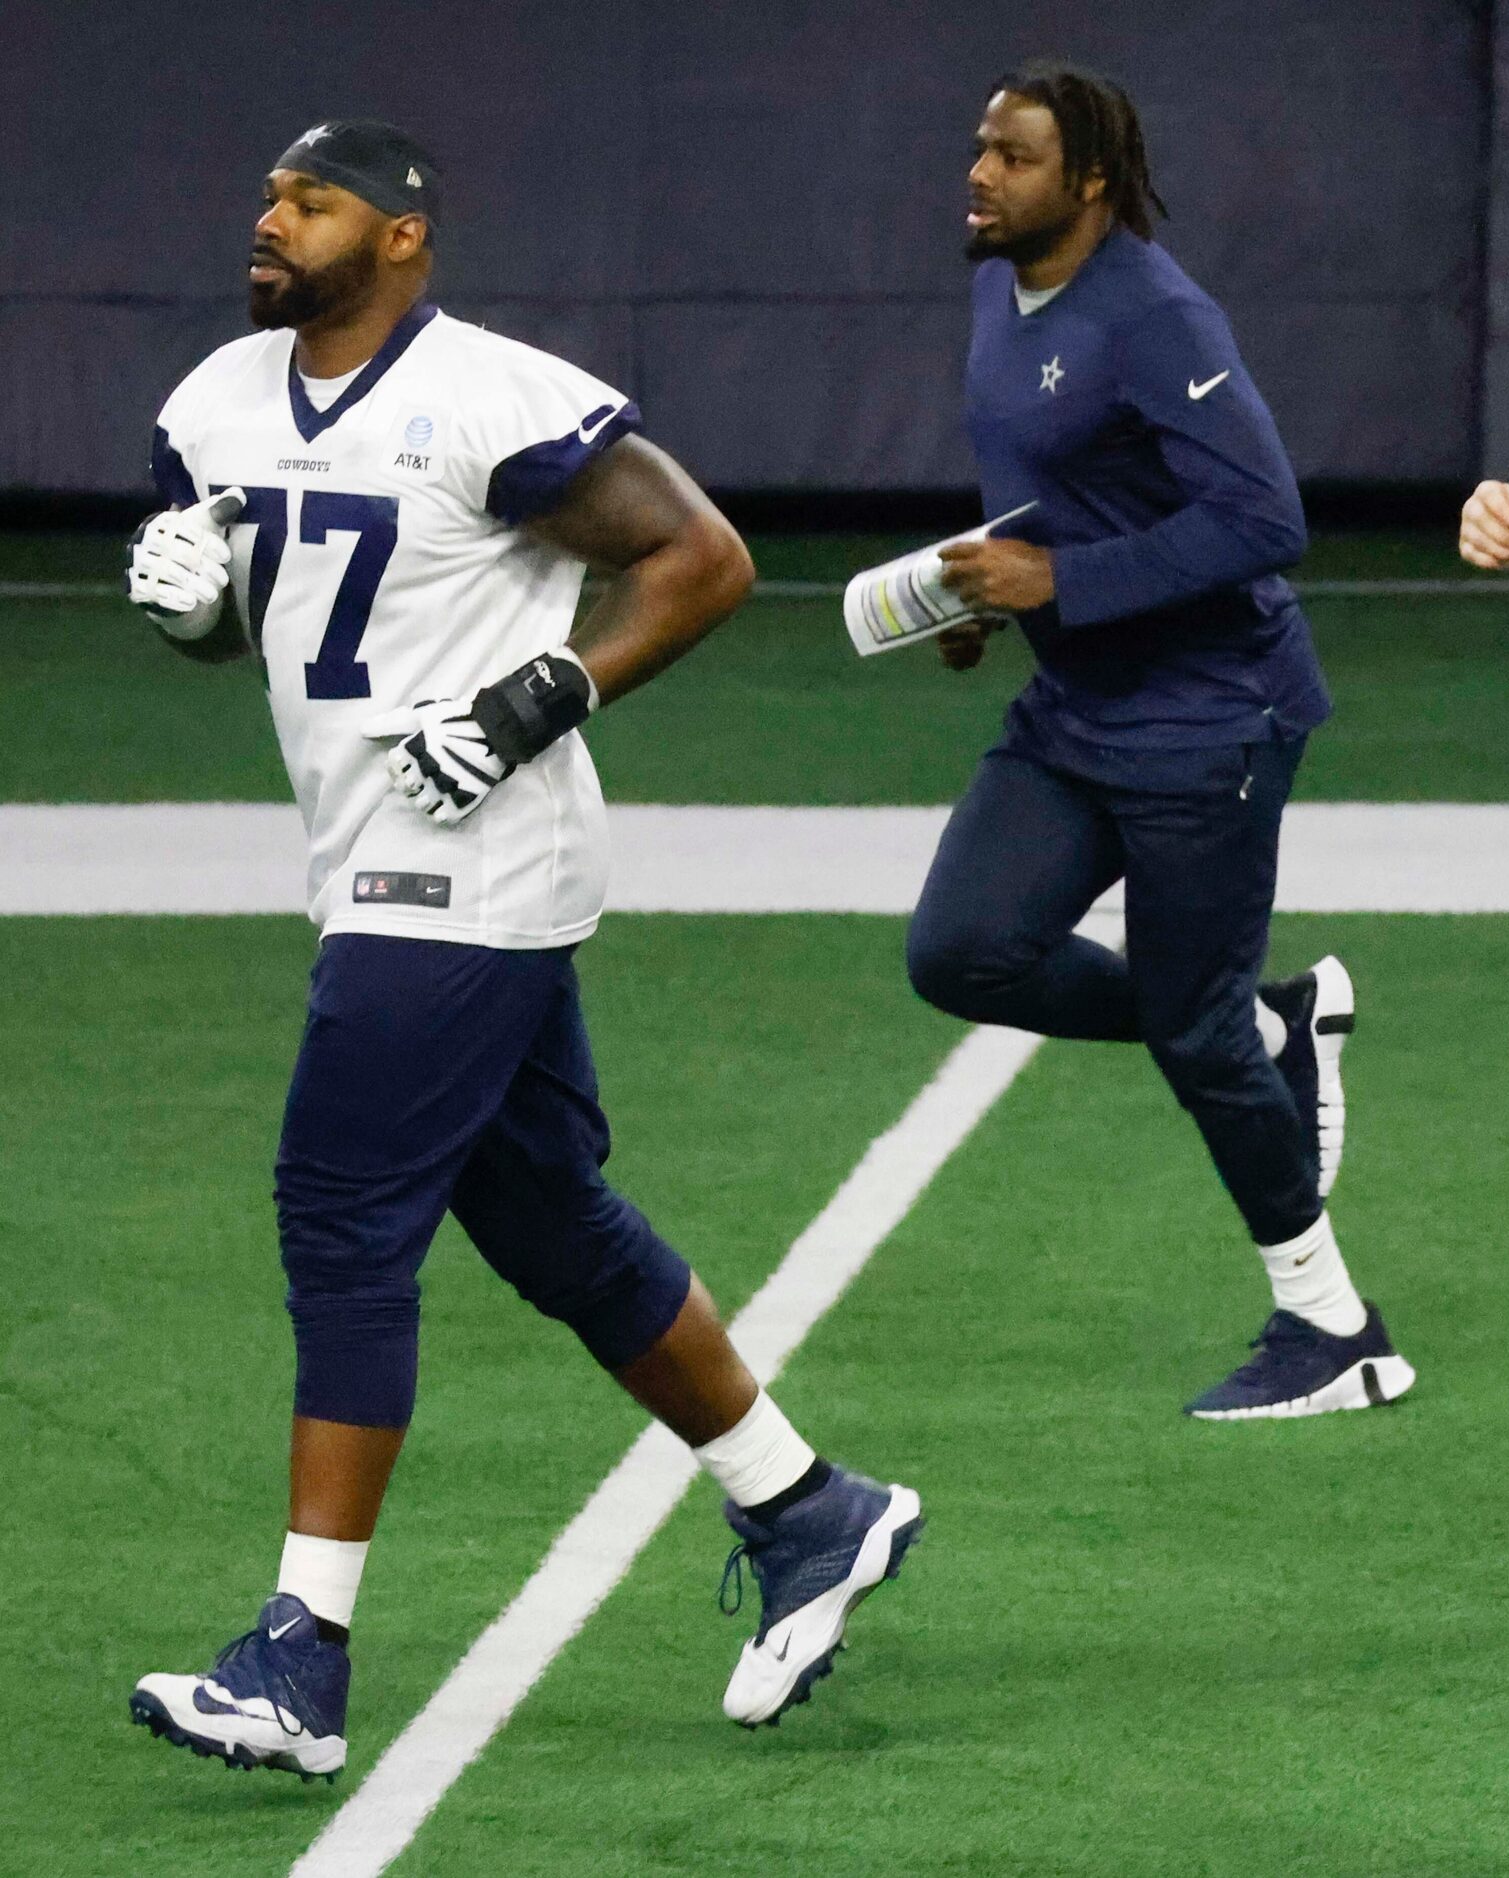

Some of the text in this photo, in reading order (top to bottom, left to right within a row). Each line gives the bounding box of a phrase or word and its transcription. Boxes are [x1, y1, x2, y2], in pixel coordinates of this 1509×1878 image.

[277, 459, 331, 472] COWBOYS
[394, 453, 431, 470] AT&T
[208, 484, 399, 701] 77
